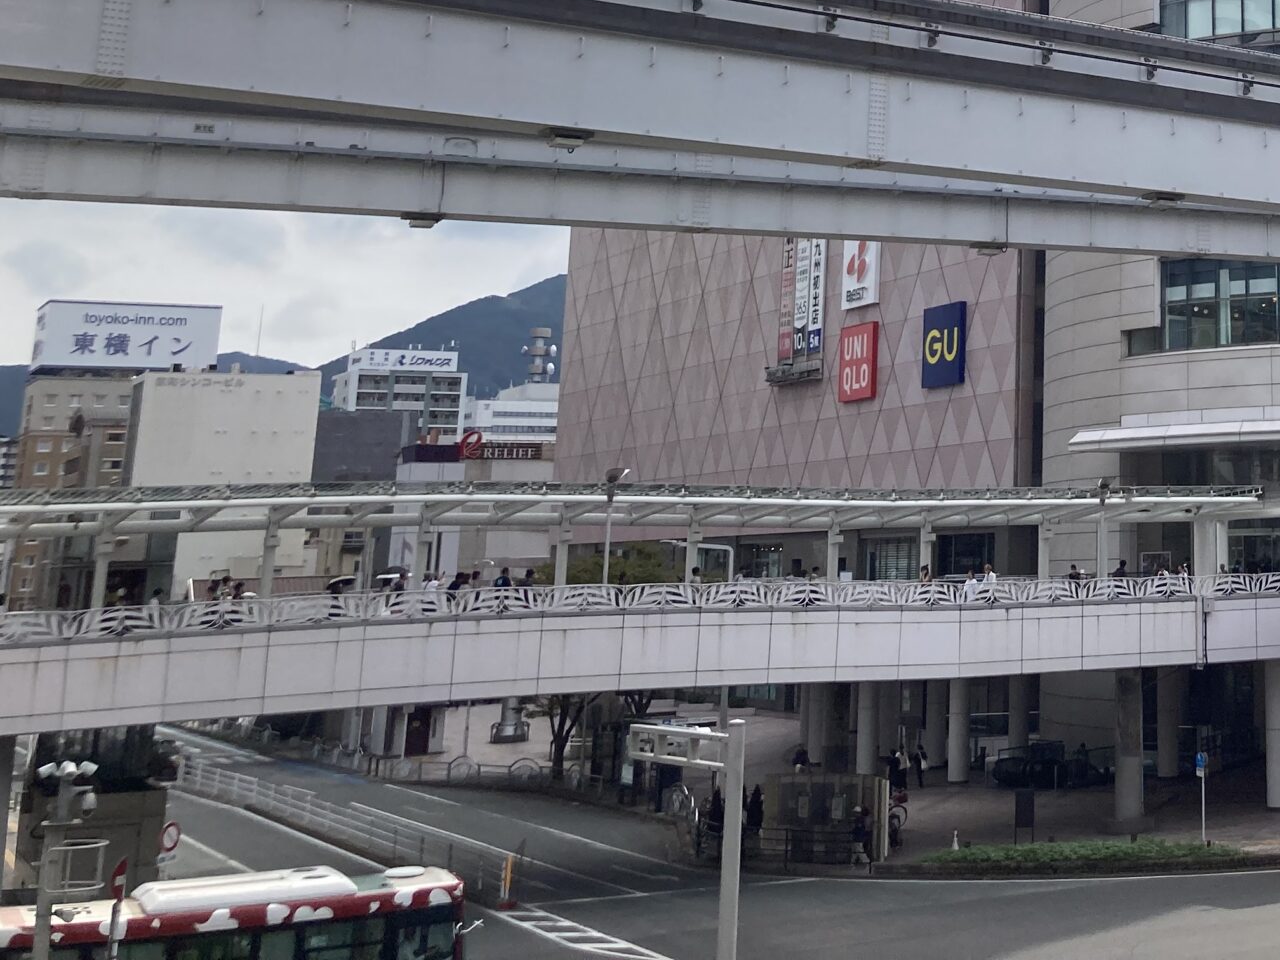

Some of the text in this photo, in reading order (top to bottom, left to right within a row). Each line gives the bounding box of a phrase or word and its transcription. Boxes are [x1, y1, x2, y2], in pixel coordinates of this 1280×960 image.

[846, 286, 867, 303] BEST
[84, 312, 188, 327] toyoko-inn.com
[70, 332, 193, 356] 東横イン
[844, 333, 867, 361] UNI
[925, 326, 958, 365] GU
[843, 363, 868, 395] QLO
[484, 447, 536, 459] RELIEF
